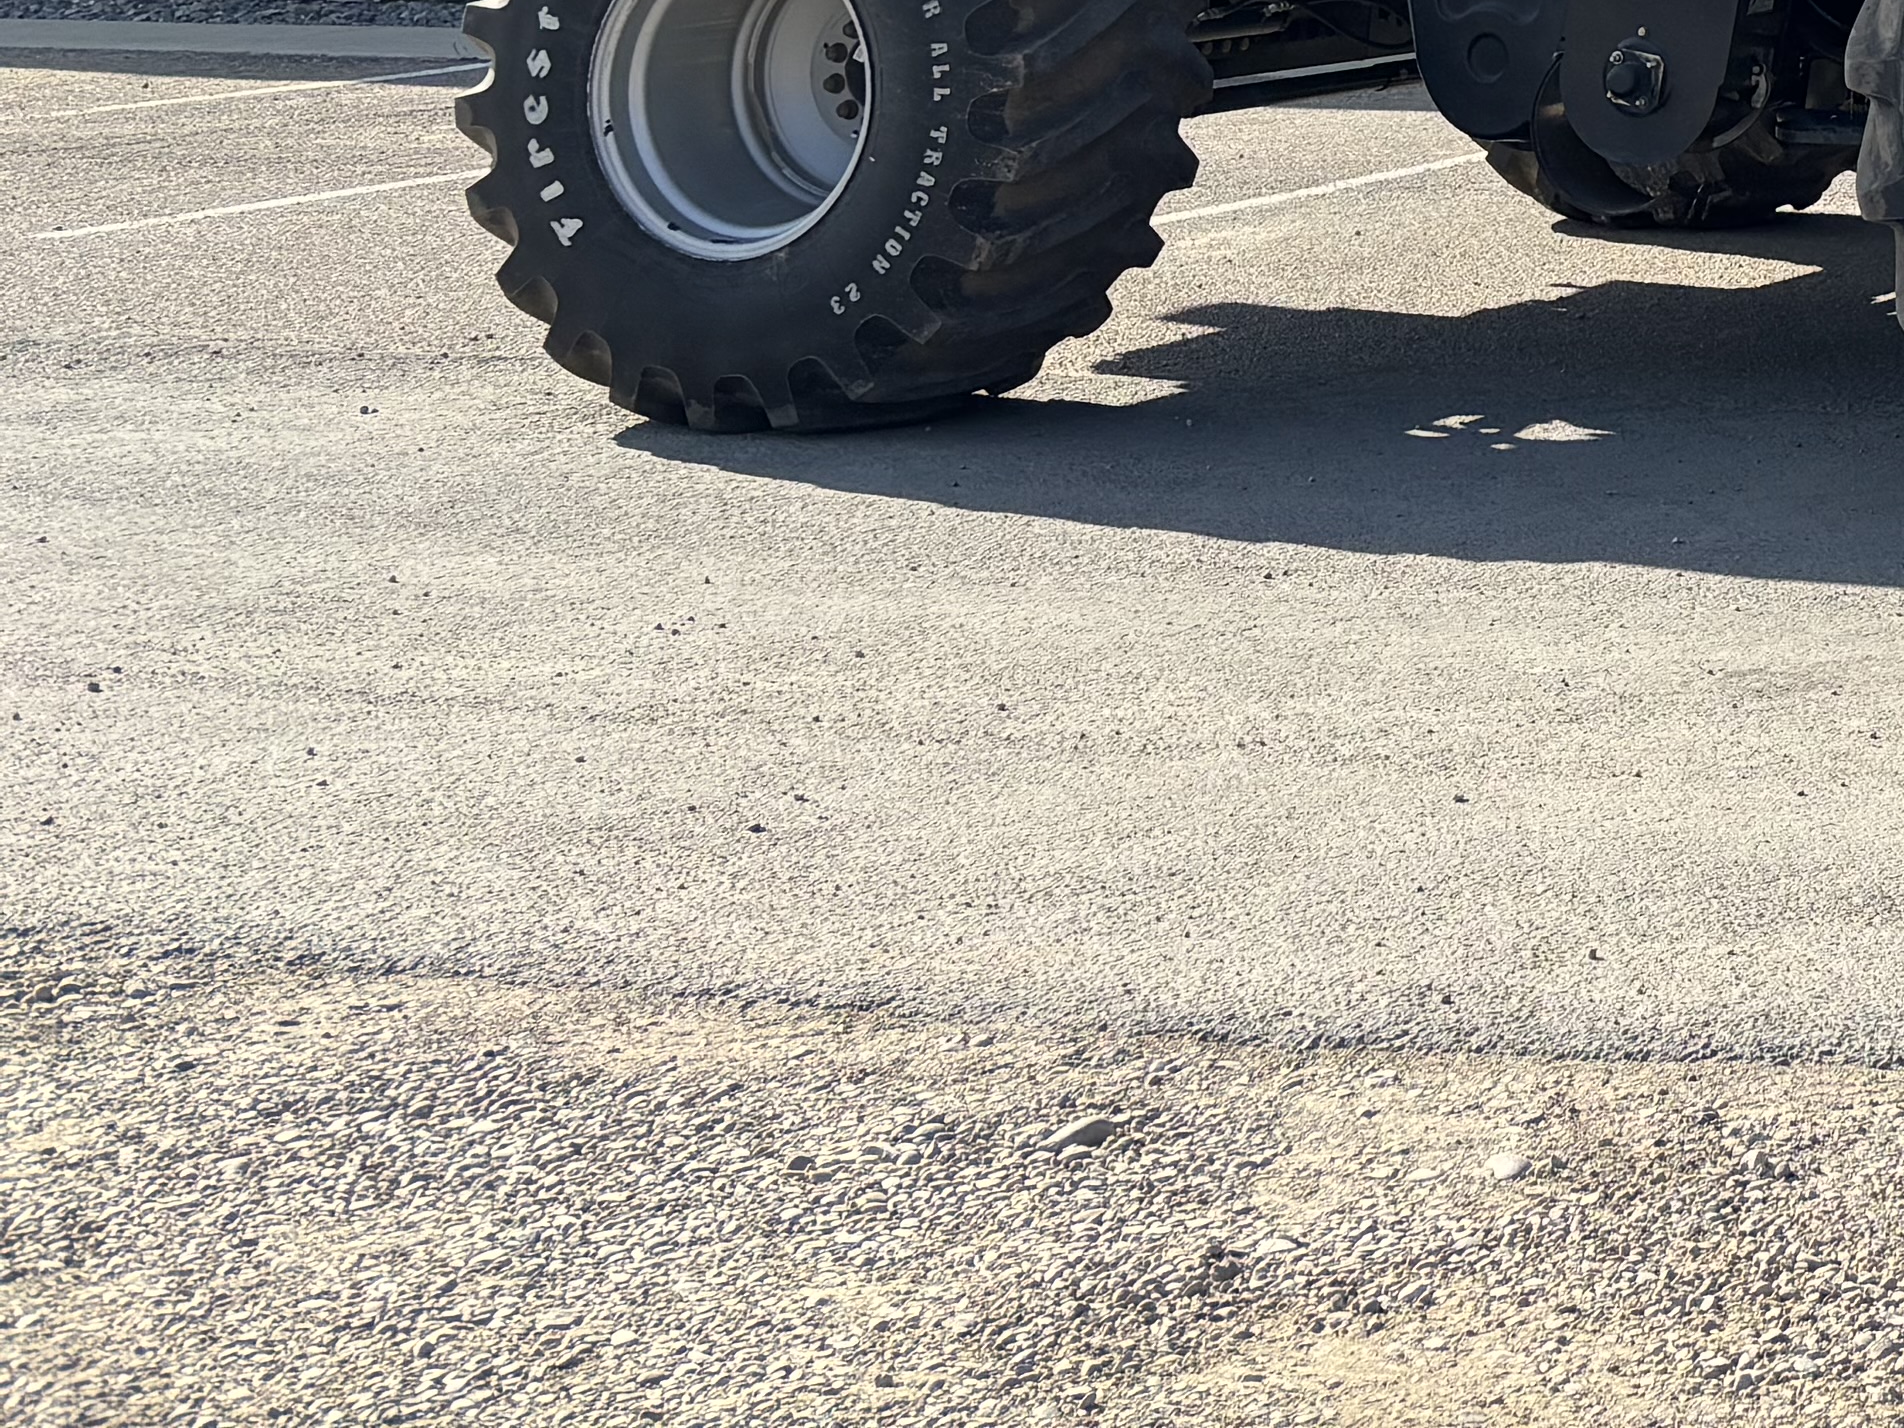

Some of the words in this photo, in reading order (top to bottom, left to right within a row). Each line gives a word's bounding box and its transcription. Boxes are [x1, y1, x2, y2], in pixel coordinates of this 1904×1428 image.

[930, 42, 951, 102] ALL
[872, 126, 949, 275] TRACTION
[829, 282, 861, 315] 23
